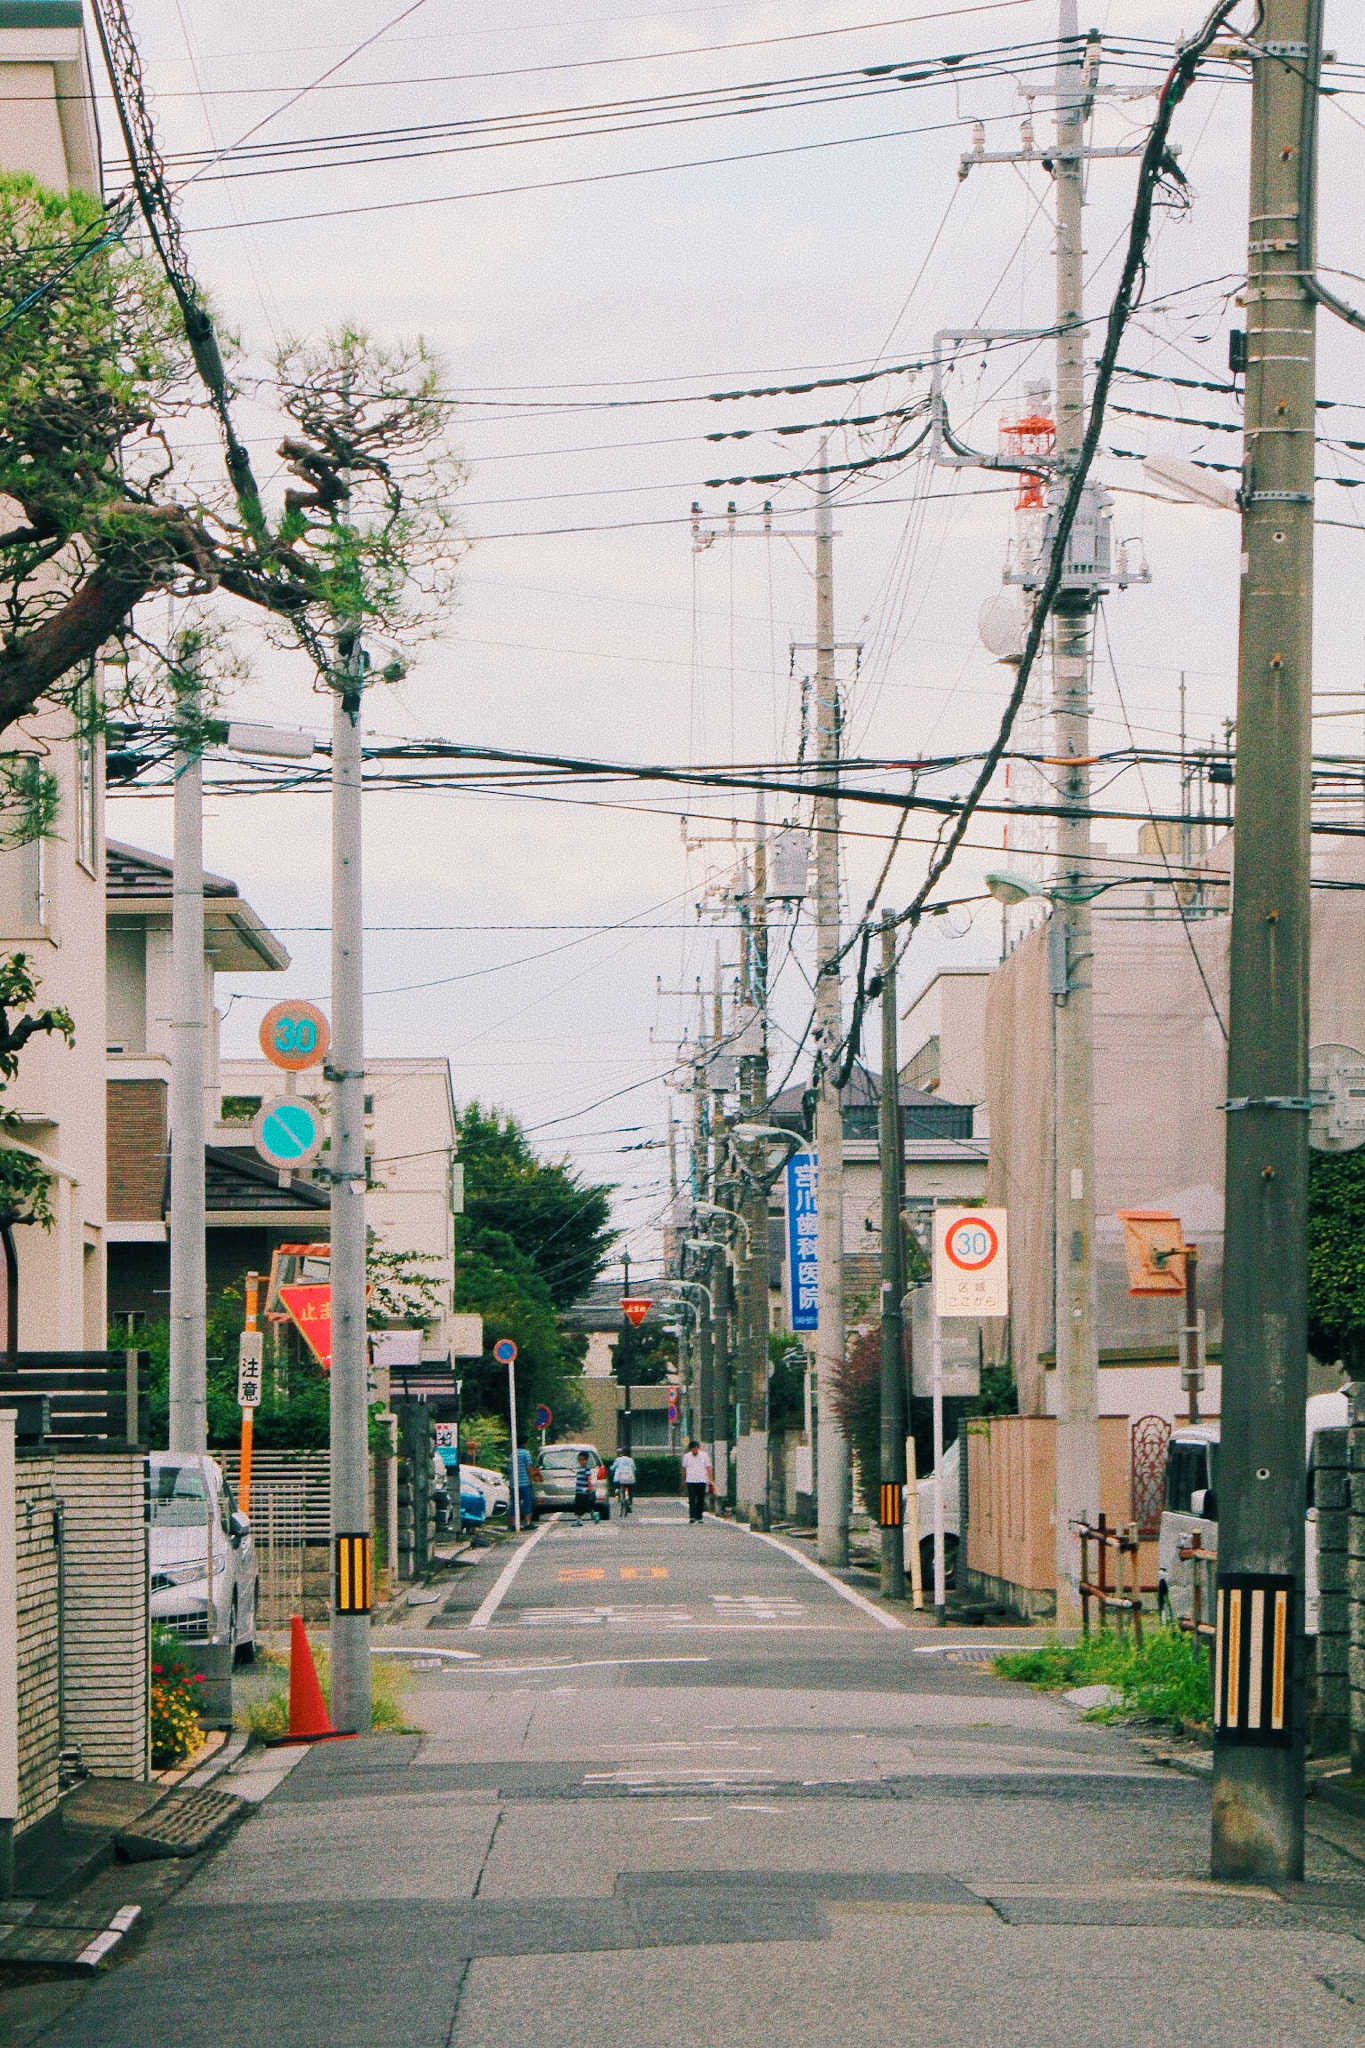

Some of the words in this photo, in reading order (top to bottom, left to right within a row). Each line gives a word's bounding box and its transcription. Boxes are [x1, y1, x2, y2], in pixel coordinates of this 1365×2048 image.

[275, 1018, 316, 1053] 30
[957, 1232, 988, 1256] 30
[300, 1302, 332, 1321] 止ま
[949, 1297, 996, 1307] ここから
[241, 1357, 259, 1403] 注意
